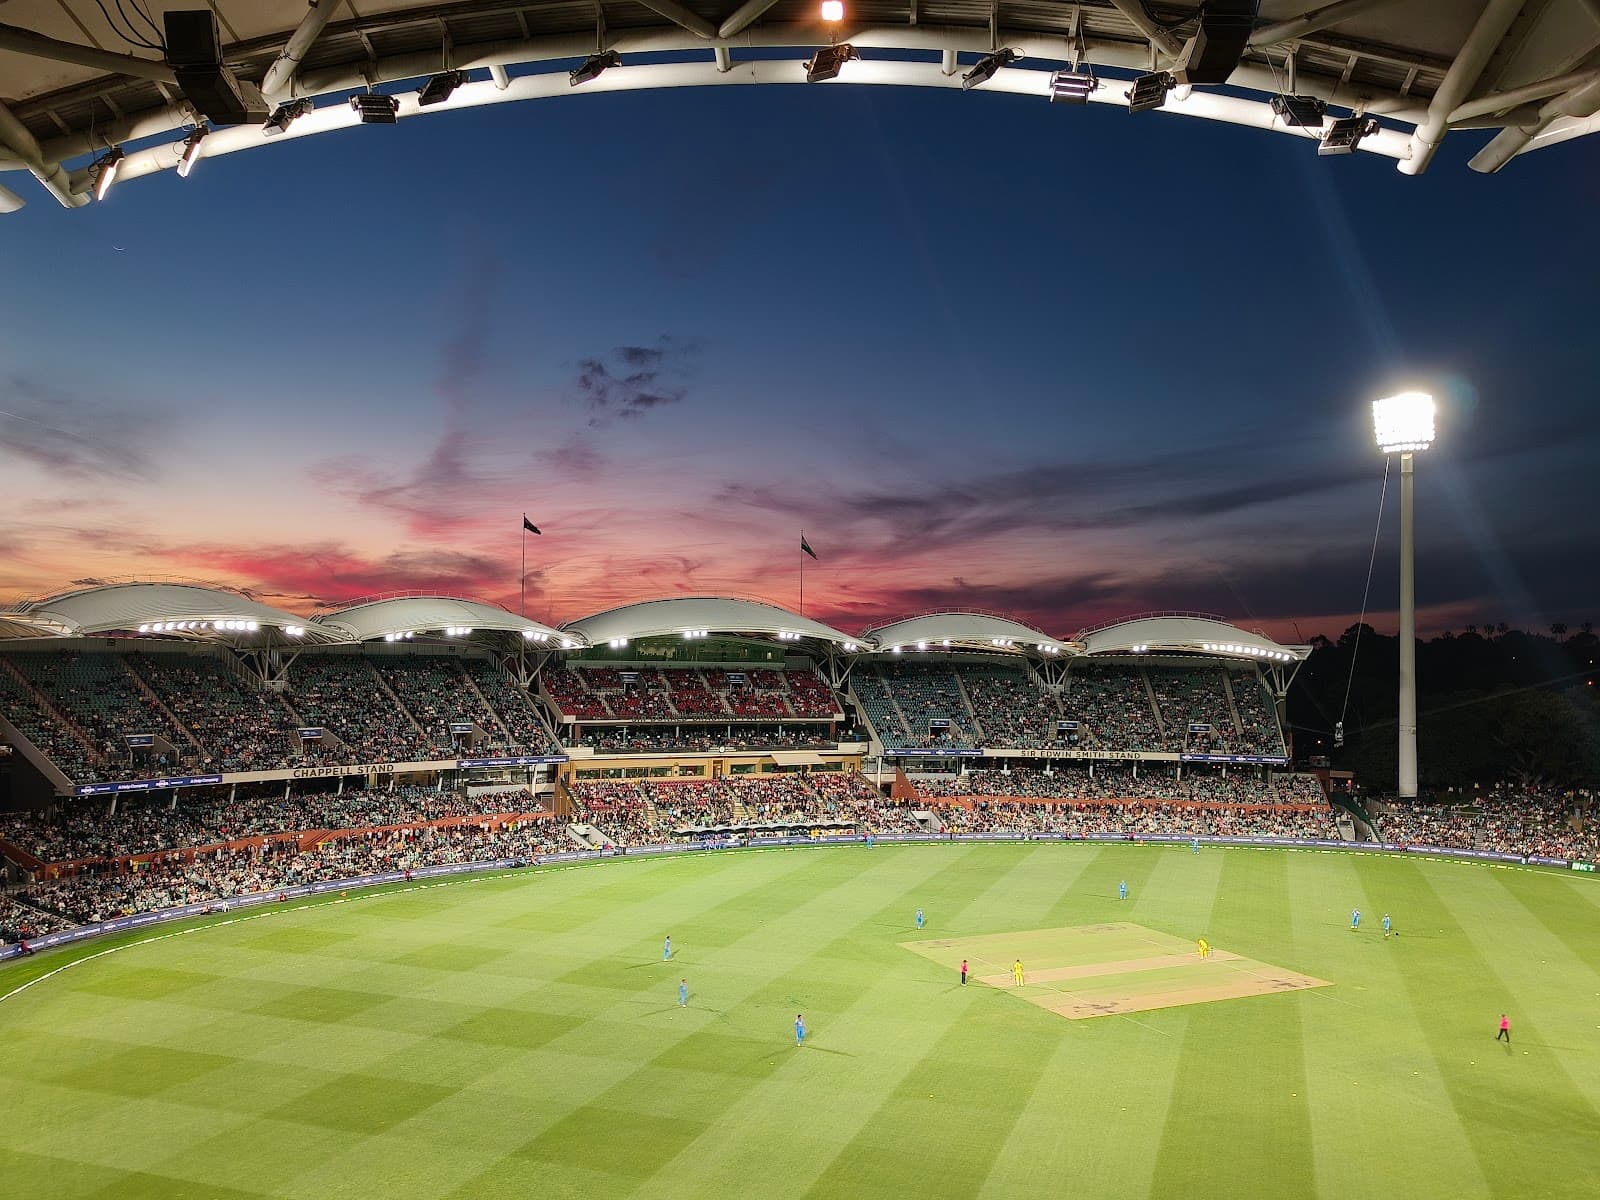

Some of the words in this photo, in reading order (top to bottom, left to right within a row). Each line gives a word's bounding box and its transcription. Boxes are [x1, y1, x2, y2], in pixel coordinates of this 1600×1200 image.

[1075, 751, 1105, 759] SMITH
[293, 767, 353, 778] CHAPPELL
[357, 764, 394, 774] STAND
